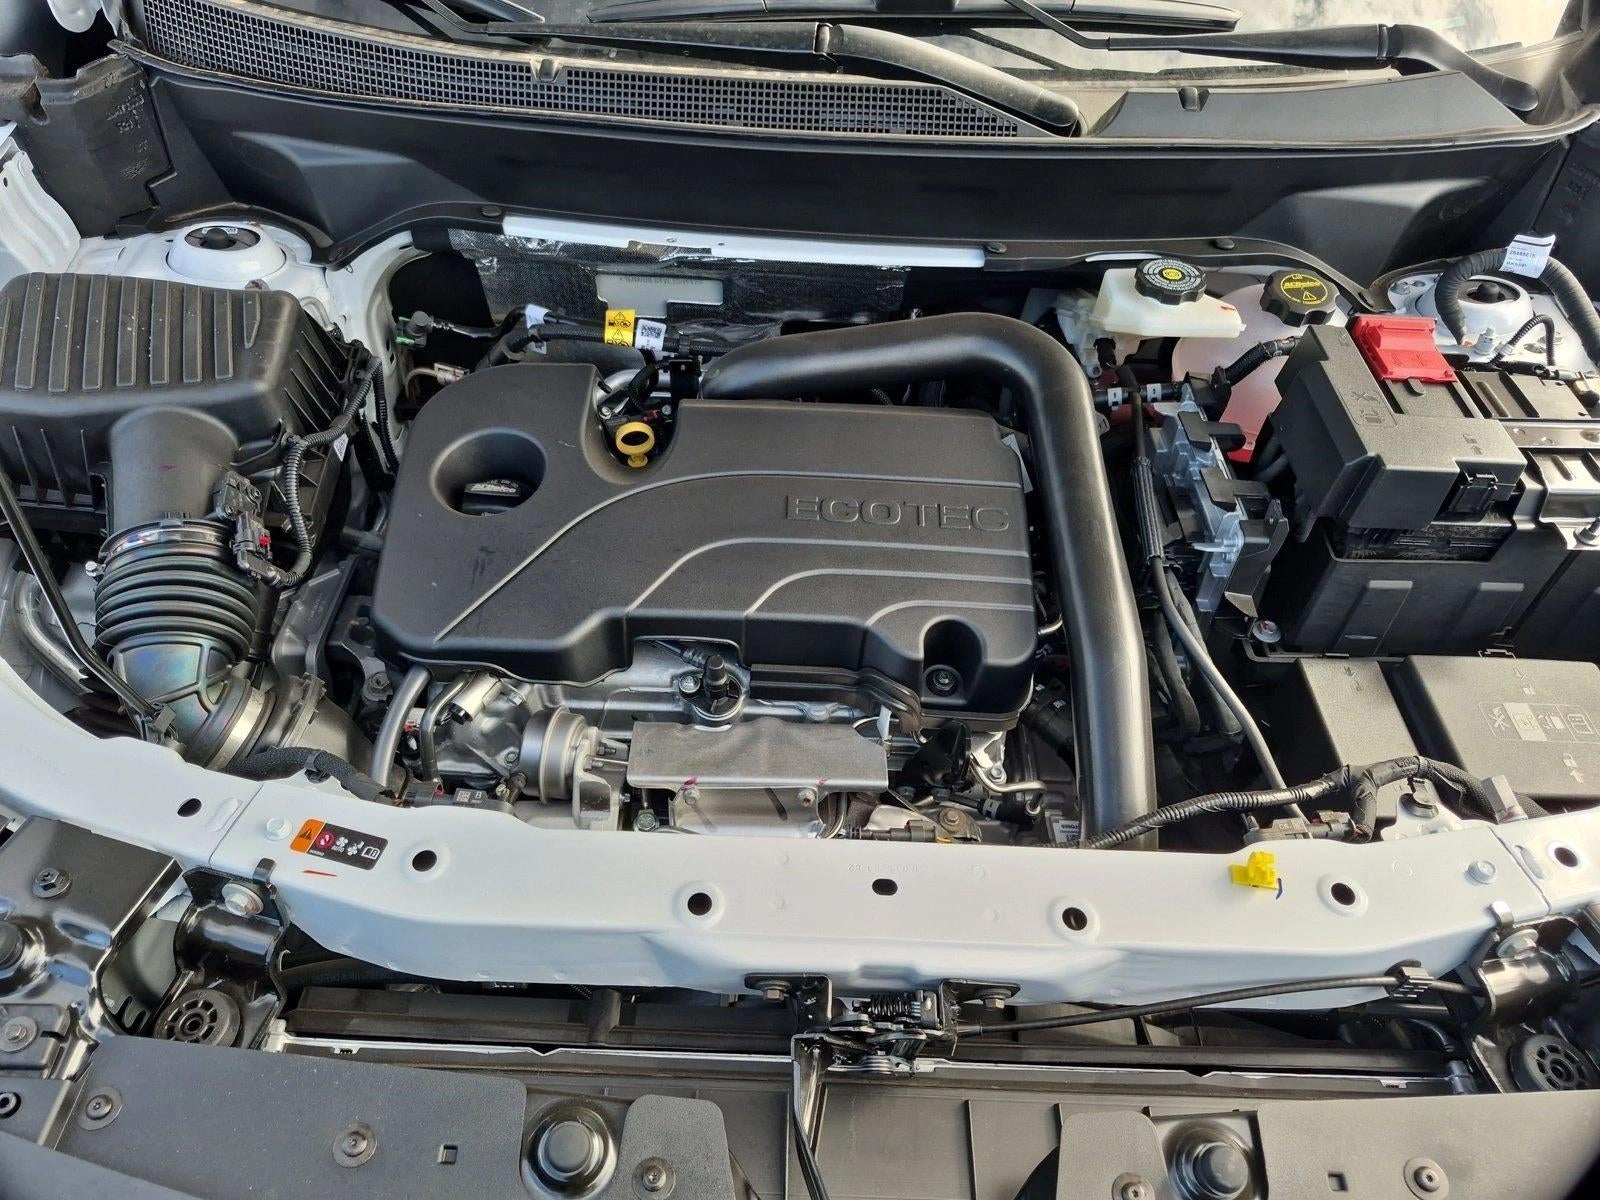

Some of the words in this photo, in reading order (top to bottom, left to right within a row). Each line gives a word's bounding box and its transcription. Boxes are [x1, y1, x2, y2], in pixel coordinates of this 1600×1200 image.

[1284, 281, 1321, 289] ACDelco
[471, 484, 517, 493] ACDelco
[786, 495, 1012, 532] ECOTEC
[331, 845, 345, 853] AUTO
